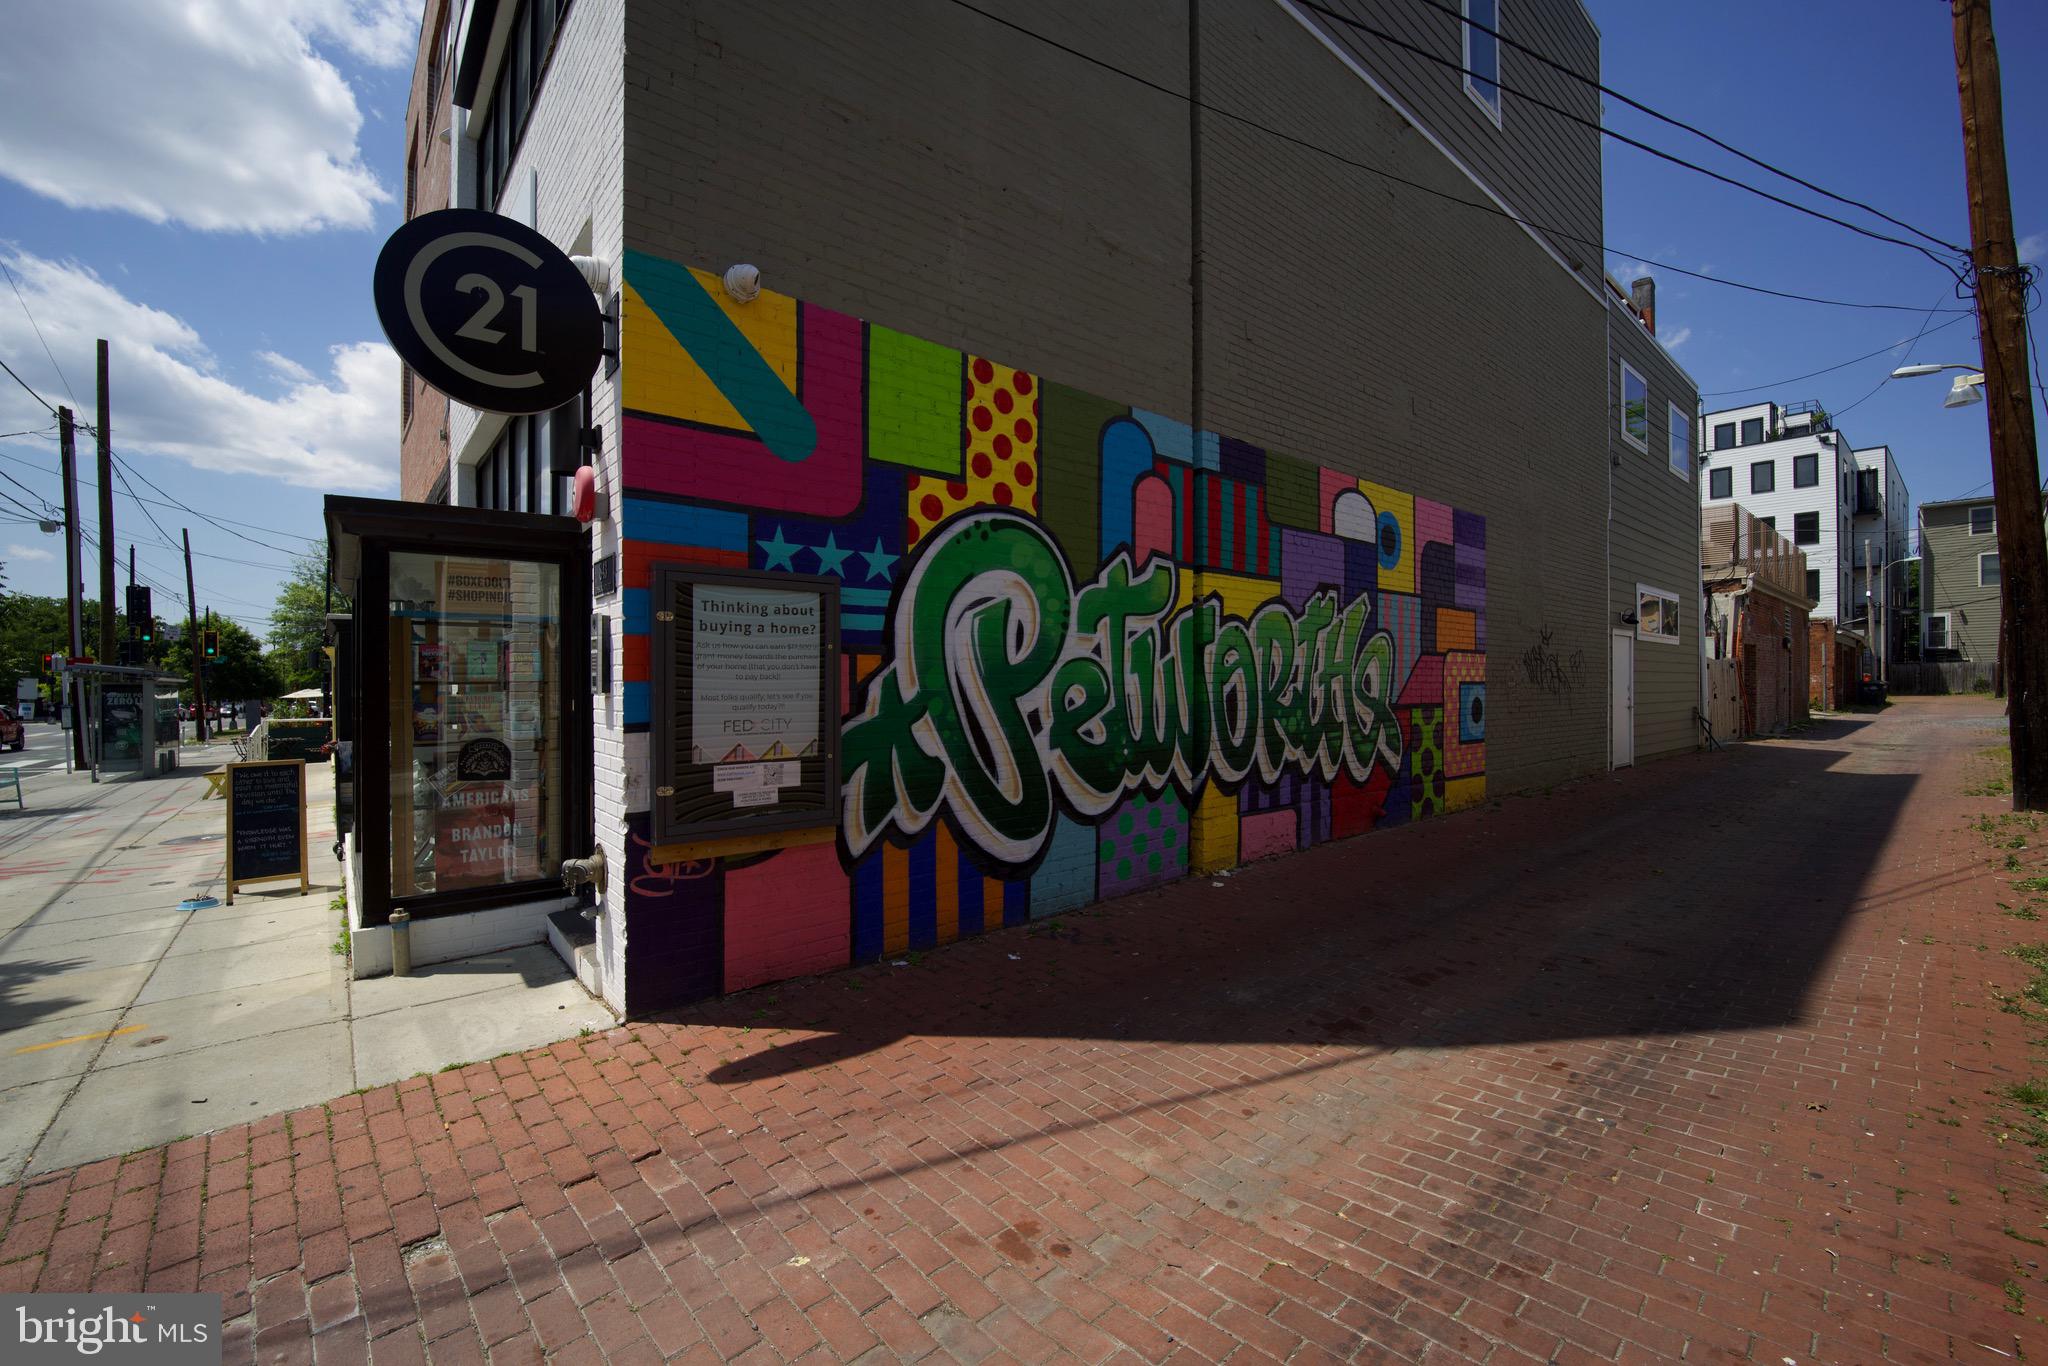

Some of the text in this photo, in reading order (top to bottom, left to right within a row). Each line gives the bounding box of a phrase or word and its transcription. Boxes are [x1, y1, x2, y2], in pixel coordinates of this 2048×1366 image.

[701, 600, 815, 617] Thinking about
[699, 620, 816, 636] buying a home?
[741, 643, 754, 651] you
[106, 697, 133, 705] ZERO
[731, 703, 756, 711] qualify
[723, 718, 792, 733] FED CITY
[442, 788, 529, 808] AMERICANS
[452, 823, 522, 842] BRANDON
[460, 845, 516, 863] TAYLOR
